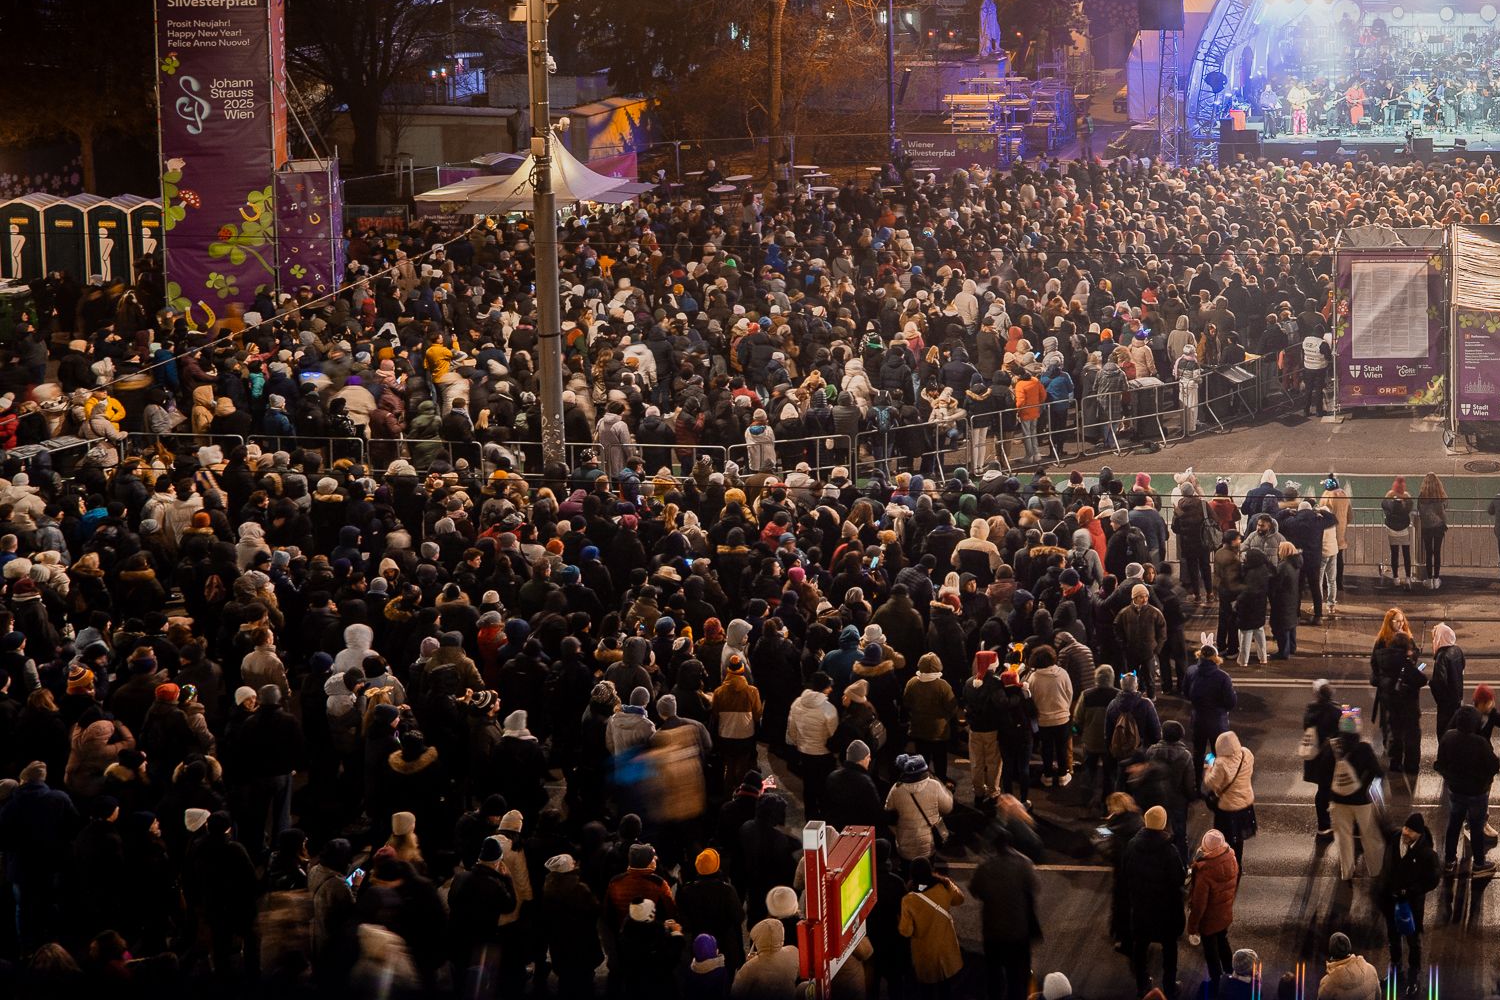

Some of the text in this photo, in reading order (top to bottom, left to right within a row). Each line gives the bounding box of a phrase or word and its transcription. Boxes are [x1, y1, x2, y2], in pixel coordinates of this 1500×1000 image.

[167, 19, 231, 29] Prosit Neujahr!
[167, 30, 196, 39] Happy
[220, 29, 242, 37] Year!
[167, 39, 250, 47] Felice Anno Nuovo!
[210, 78, 254, 89] Johann
[210, 88, 254, 98] Strauss
[224, 99, 254, 109] 2025
[224, 109, 255, 119] Wien
[907, 149, 956, 158] Silvesterpfad
